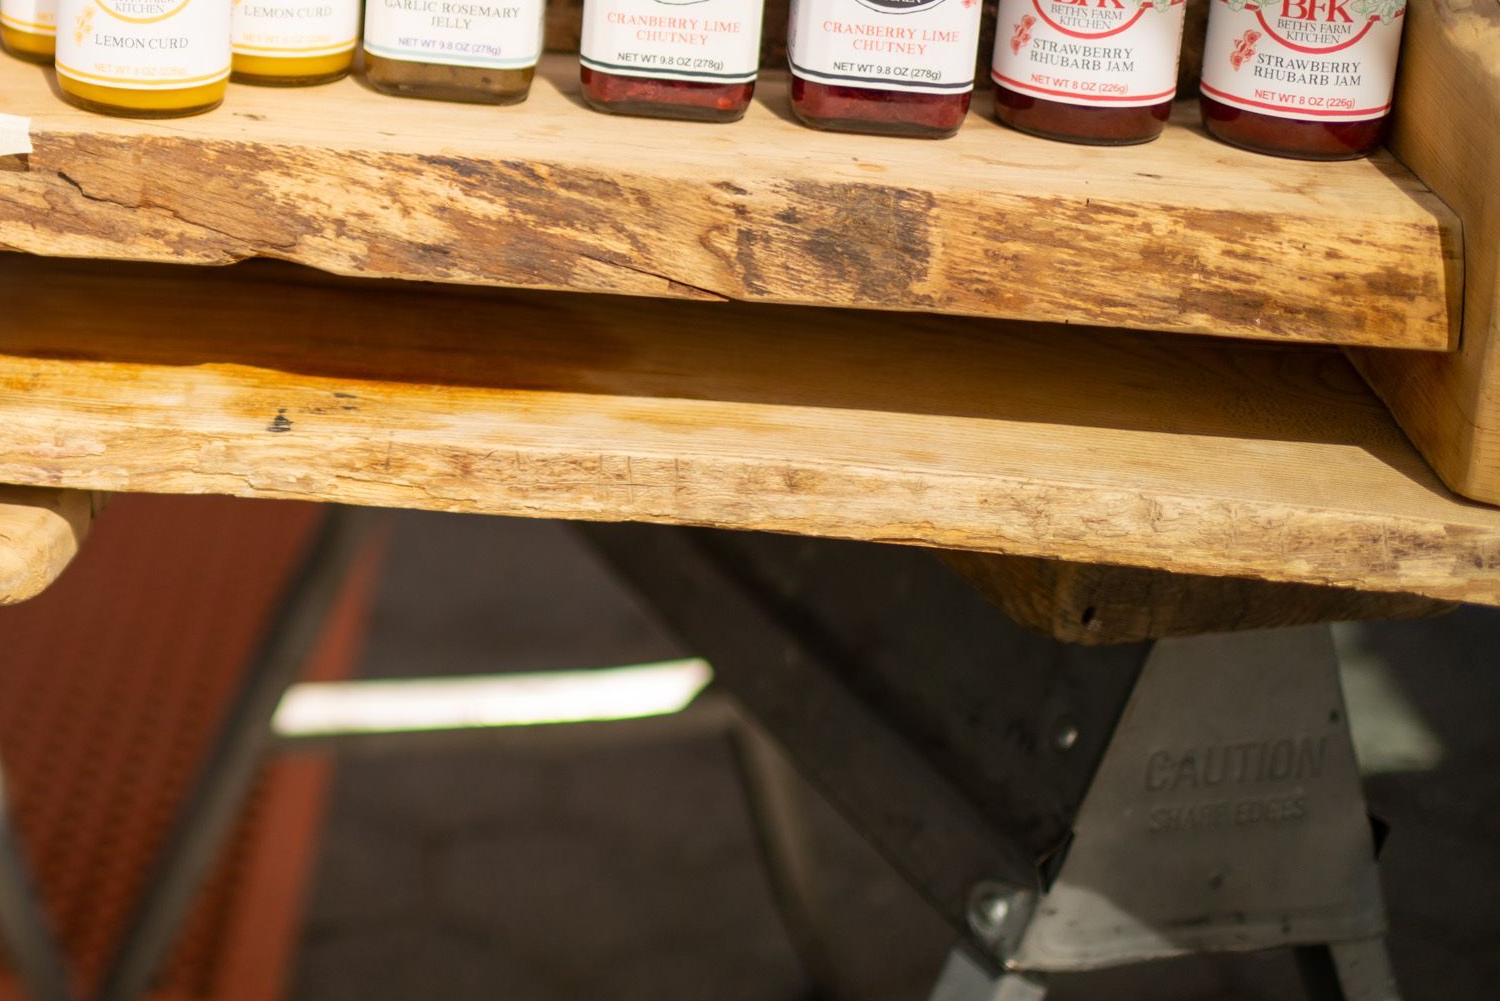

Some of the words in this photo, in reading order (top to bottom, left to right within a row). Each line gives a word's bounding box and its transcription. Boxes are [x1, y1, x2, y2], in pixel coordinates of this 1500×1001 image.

[115, 2, 164, 14] KITCHEN
[243, 4, 294, 18] LEMON
[296, 6, 332, 18] CURD
[442, 2, 520, 19] ROSEMARY
[1051, 3, 1088, 18] BETH'S
[1091, 8, 1123, 21] FARM
[431, 16, 472, 30] JELLY
[607, 11, 698, 31] CRANBERRY
[704, 20, 741, 34] LIME
[1060, 15, 1111, 30] KITCHEN
[1277, 18, 1316, 32] BETH'S
[1320, 22, 1352, 34] FARM
[636, 30, 709, 46] CHUTNEY
[823, 20, 917, 41] CRANBERRY
[923, 30, 960, 44] LIME
[1287, 30, 1340, 44] KITCHEN
[95, 33, 145, 49] LEMON
[148, 37, 189, 50] CURD
[399, 37, 418, 48] NET
[421, 39, 436, 49] WT
[455, 42, 470, 53] OZ
[853, 39, 927, 56] CHUTNEY
[1033, 38, 1133, 60] STRAWBERRY
[617, 52, 637, 63] NET
[640, 54, 657, 65] WT
[660, 55, 674, 65] 9.8
[676, 57, 691, 67] OZ
[694, 58, 724, 72] (278g)
[1030, 50, 1101, 71] RHUBARB
[1106, 61, 1134, 73] JAM
[1257, 53, 1361, 73] STRAWBERRY
[833, 61, 854, 72] NET
[857, 63, 874, 73] WT
[877, 64, 891, 75] 9.8
[893, 66, 908, 77] OZ
[911, 68, 942, 81] (278g)
[1254, 65, 1329, 85] RHUBARB
[1334, 74, 1362, 87] JAM
[1031, 73, 1050, 85] NET
[1053, 77, 1069, 89] WT
[1072, 79, 1078, 90] 8
[1081, 82, 1097, 93] OZ
[1099, 82, 1129, 95] (226g)
[1255, 89, 1275, 100] NET
[1278, 92, 1296, 104] WT
[1299, 94, 1305, 105] 8
[1308, 96, 1324, 107] OZ
[1326, 98, 1355, 109] (226g)
[1145, 736, 1327, 792] CAUTION
